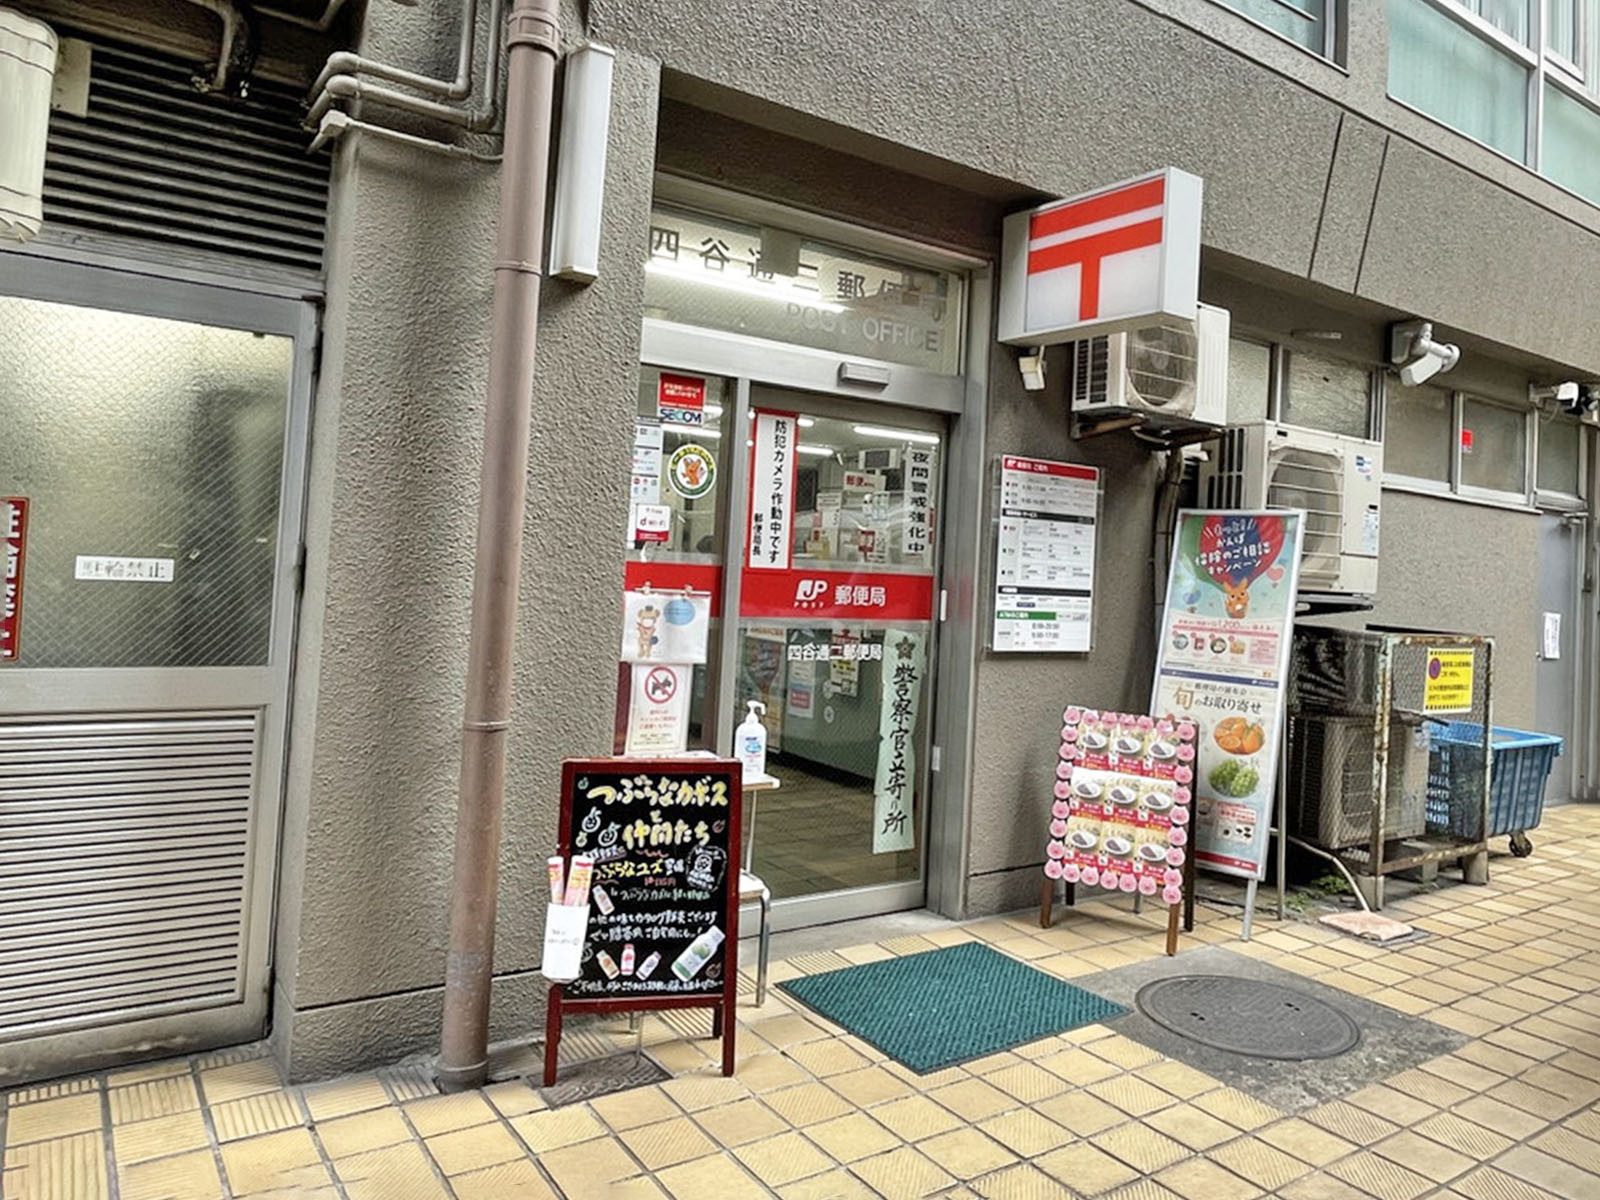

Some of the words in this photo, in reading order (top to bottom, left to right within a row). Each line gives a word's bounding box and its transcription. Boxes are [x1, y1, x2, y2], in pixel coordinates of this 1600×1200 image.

[863, 319, 940, 352] OFFICE
[659, 409, 702, 423] SECOM
[767, 419, 788, 564] 防犯カメラ作動中です
[908, 450, 930, 553] 夜間警戒強化中
[752, 512, 764, 557] 郵便局長
[1194, 541, 1271, 566] 保険のご相談
[1208, 559, 1262, 575] キャンペーン
[79, 560, 166, 579] 駐輪禁止
[796, 579, 828, 600] JP
[834, 584, 886, 607] 郵便局
[787, 643, 883, 661] 四谷通二郵便局
[1174, 686, 1262, 714] 旬のお取り寄せ
[881, 662, 919, 837] 警察官立寄り所
[586, 775, 728, 806] つぶらなカボス
[650, 810, 662, 823] と
[622, 819, 710, 850] 仲間たち
